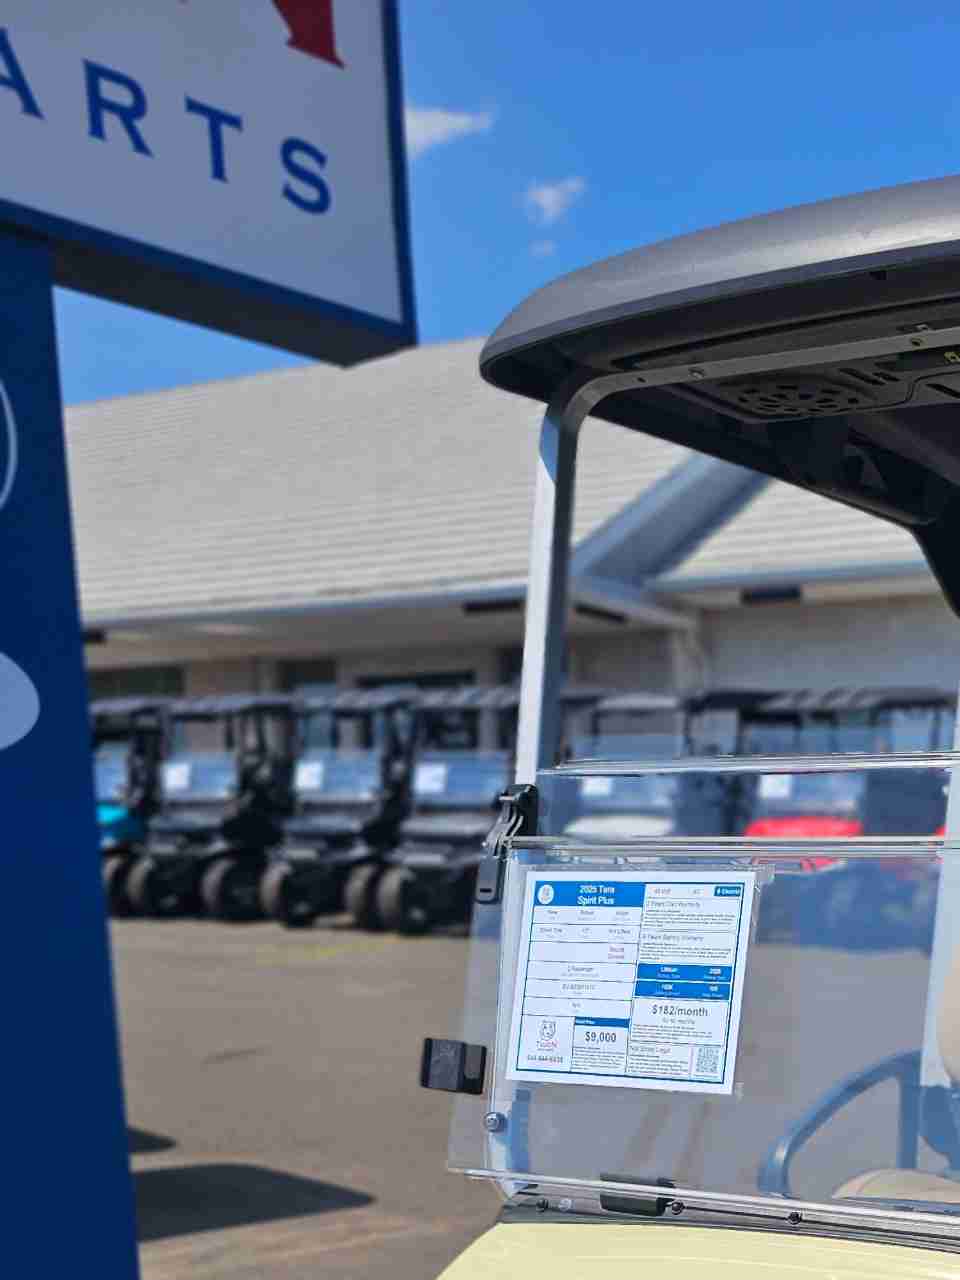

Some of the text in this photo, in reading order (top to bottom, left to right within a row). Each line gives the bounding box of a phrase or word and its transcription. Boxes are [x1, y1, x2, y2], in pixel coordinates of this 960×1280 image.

[577, 896, 615, 906] Spirit Plus
[652, 1004, 708, 1017] $182/month
[585, 1031, 617, 1044] $9,000
